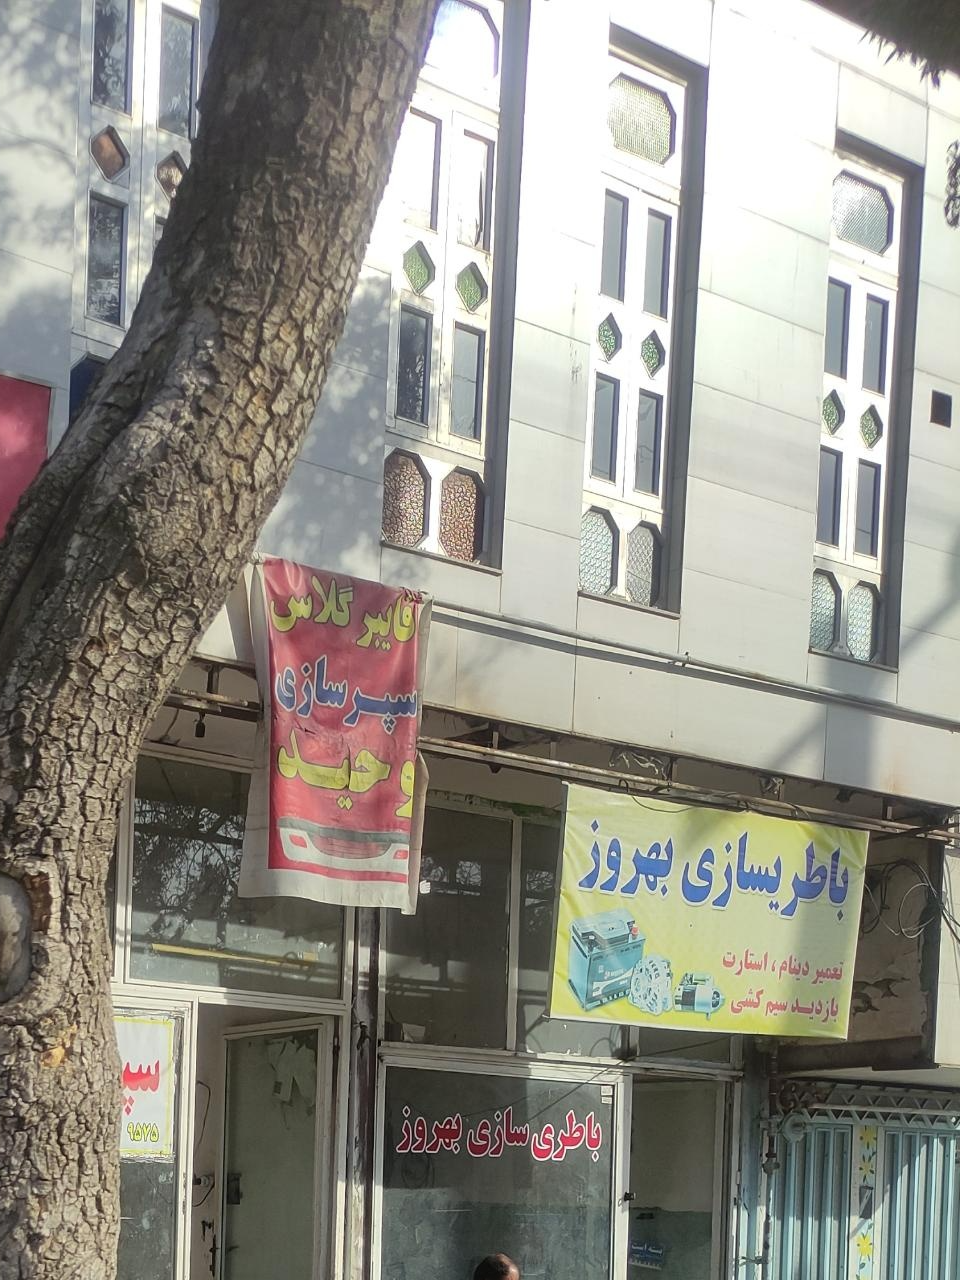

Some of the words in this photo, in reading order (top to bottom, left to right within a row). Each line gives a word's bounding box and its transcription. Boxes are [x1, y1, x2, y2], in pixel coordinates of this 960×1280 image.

[270, 575, 354, 633] گلاس
[356, 590, 417, 650] فایبر
[277, 729, 415, 818] وحید
[577, 818, 675, 898] بهروز
[722, 948, 768, 976] استارت
[811, 961, 843, 985] تعمیر
[765, 1000, 788, 1016] سیم
[791, 997, 839, 1023] بازدید
[126, 1121, 160, 1143] ۹۵۷۵
[396, 1105, 463, 1154] بهروز
[467, 1105, 530, 1158] سازی
[531, 1109, 603, 1163] باطری
